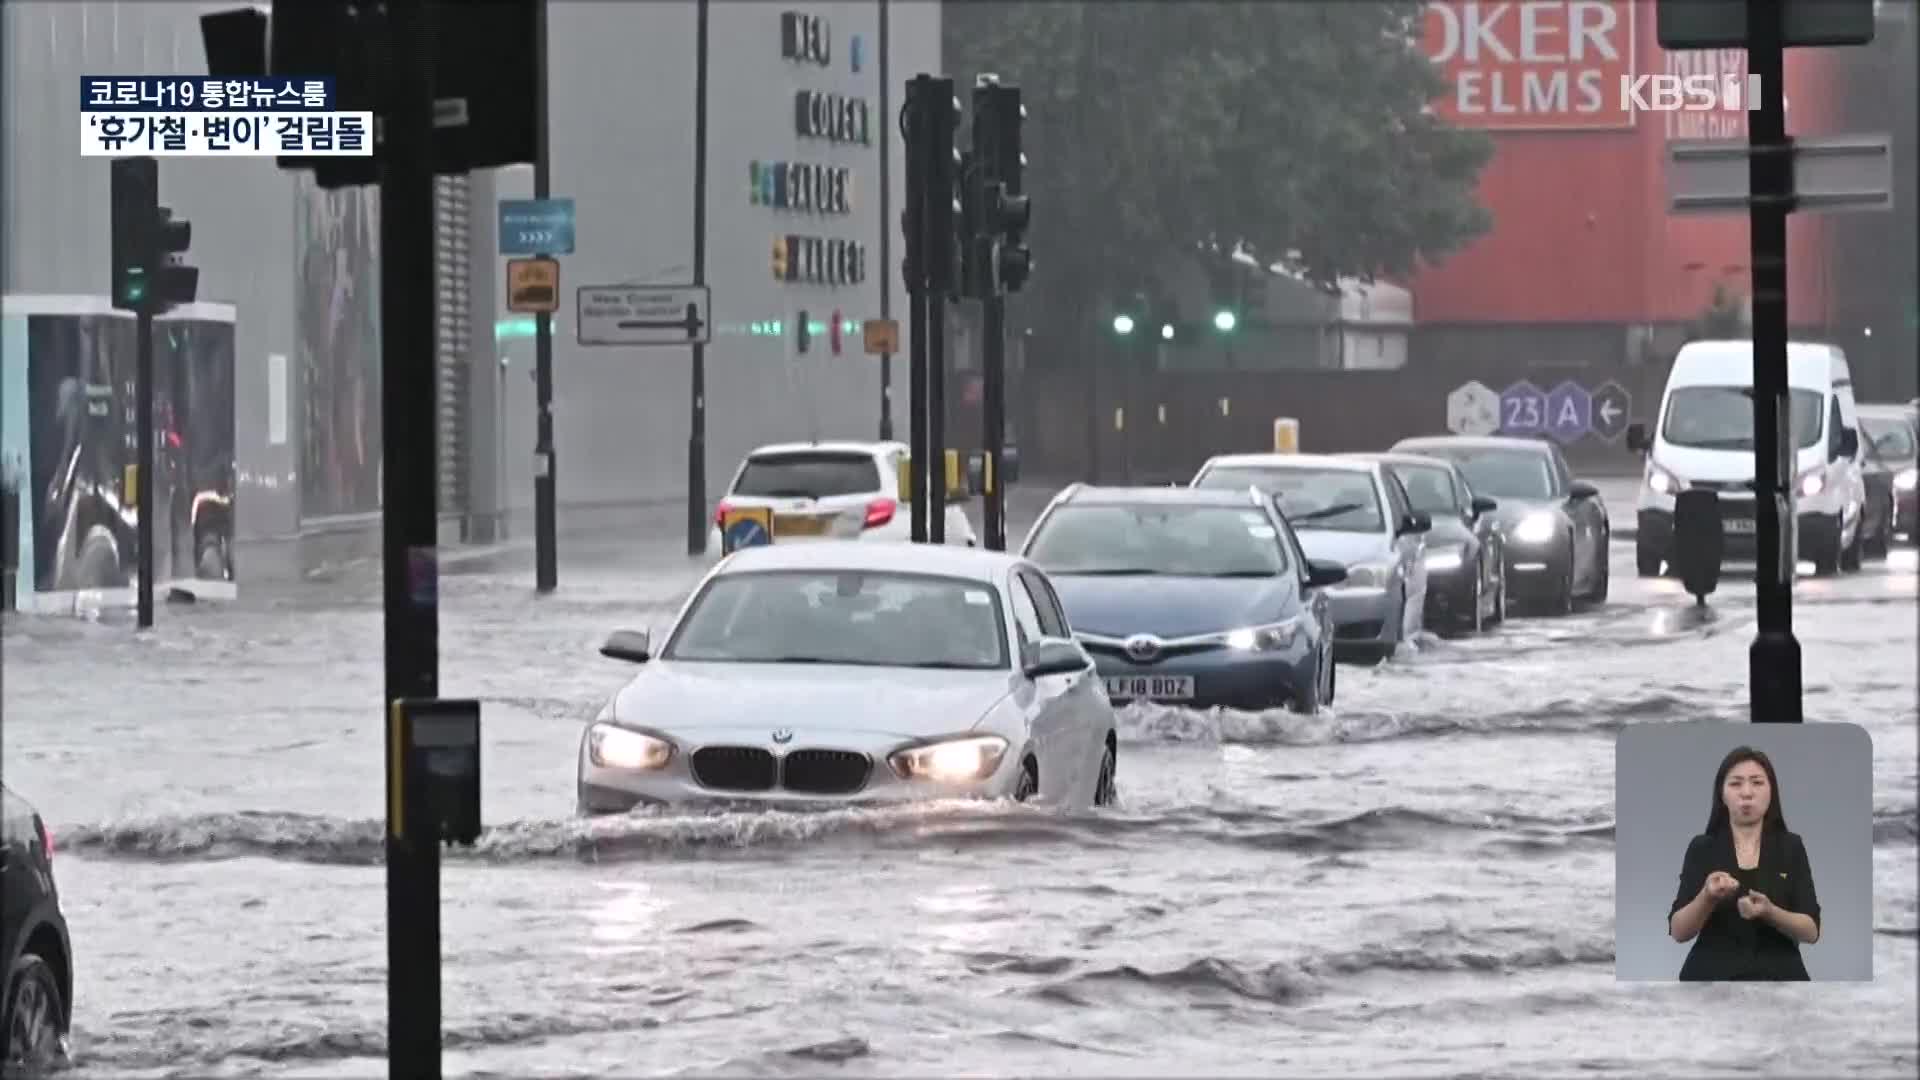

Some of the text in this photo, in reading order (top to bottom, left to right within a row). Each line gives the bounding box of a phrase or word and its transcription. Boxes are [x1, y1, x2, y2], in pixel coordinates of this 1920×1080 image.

[1457, 69, 1603, 114] ELMS
[1506, 397, 1580, 427] 23 A
